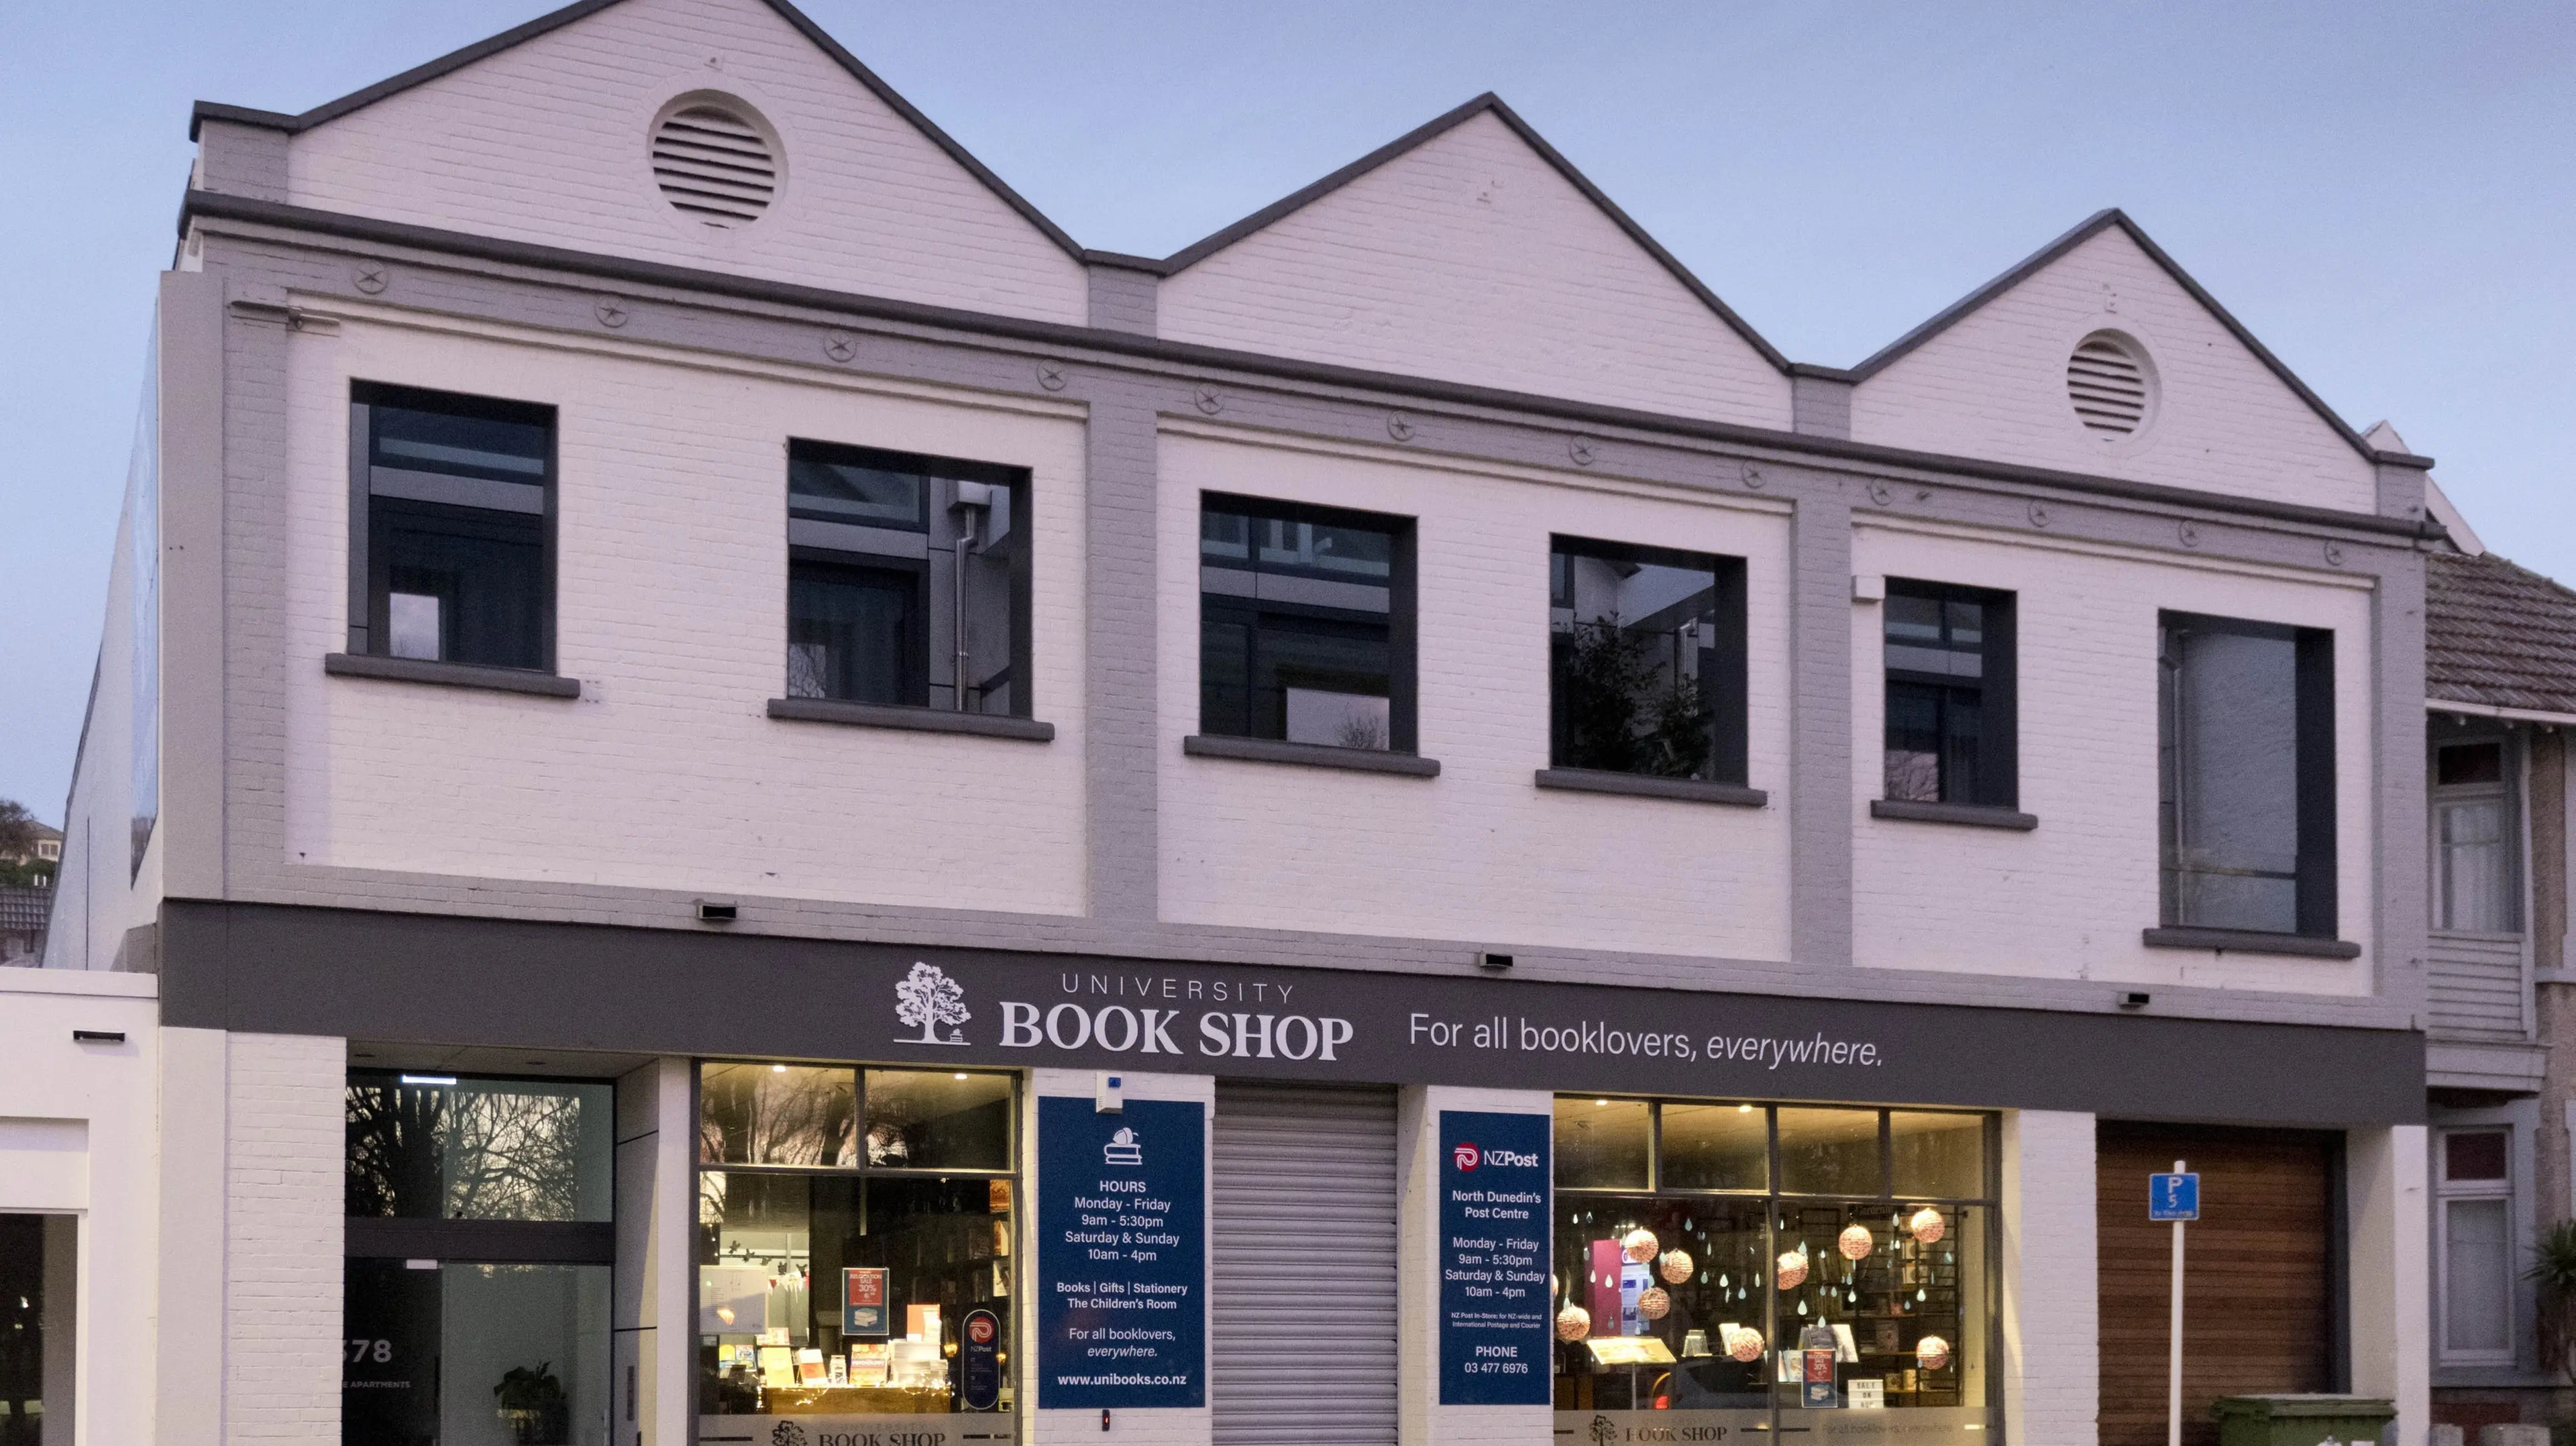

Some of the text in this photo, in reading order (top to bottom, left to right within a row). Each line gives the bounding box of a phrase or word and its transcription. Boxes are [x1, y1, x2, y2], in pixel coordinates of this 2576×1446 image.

[1062, 973, 1293, 1004] UNIVERSITY
[999, 1001, 1354, 1062] BOOK SHOP
[1410, 1013, 1883, 1070] For all booklovers, everywhere.
[1484, 1150, 1539, 1168] NZPost
[1099, 1180, 1146, 1192] HOURS
[2168, 1177, 2183, 1194] P
[1452, 1190, 1542, 1203] North Dunedin's
[1075, 1197, 1122, 1212] Monday
[1134, 1199, 1171, 1213] Friday
[1465, 1207, 1529, 1219] Post Centre
[1081, 1215, 1107, 1225] 9am
[1120, 1215, 1164, 1229] 5:30pm
[1065, 1231, 1180, 1247] Saturday & Sunday
[1453, 1237, 1496, 1252] Monday
[1507, 1239, 1539, 1252] Friday
[1088, 1249, 1119, 1260] 10am
[1131, 1250, 1157, 1263] 4pm
[1458, 1254, 1482, 1264] 9am
[1493, 1255, 1532, 1267] 5:30pm
[1445, 1270, 1546, 1284] Saturday & Sunday
[859, 1284, 877, 1292] 30%
[1057, 1282, 1091, 1293] Books
[1099, 1282, 1125, 1293] Gifts
[1134, 1283, 1187, 1296] Stationery
[1465, 1286, 1492, 1296] 10am
[1502, 1287, 1525, 1299] 4pm
[1068, 1298, 1177, 1309] The Children's Room
[1069, 1328, 1176, 1341] For all booklovers,
[1087, 1345, 1158, 1359] everywhere.
[1476, 1346, 1517, 1357] PHONE
[1464, 1363, 1528, 1374] 03 477 6976
[1058, 1373, 1187, 1386] www.unibooks.co.nz
[818, 1433, 946, 1446] BOOK SHOP
[1681, 1427, 1727, 1441] SHOP
